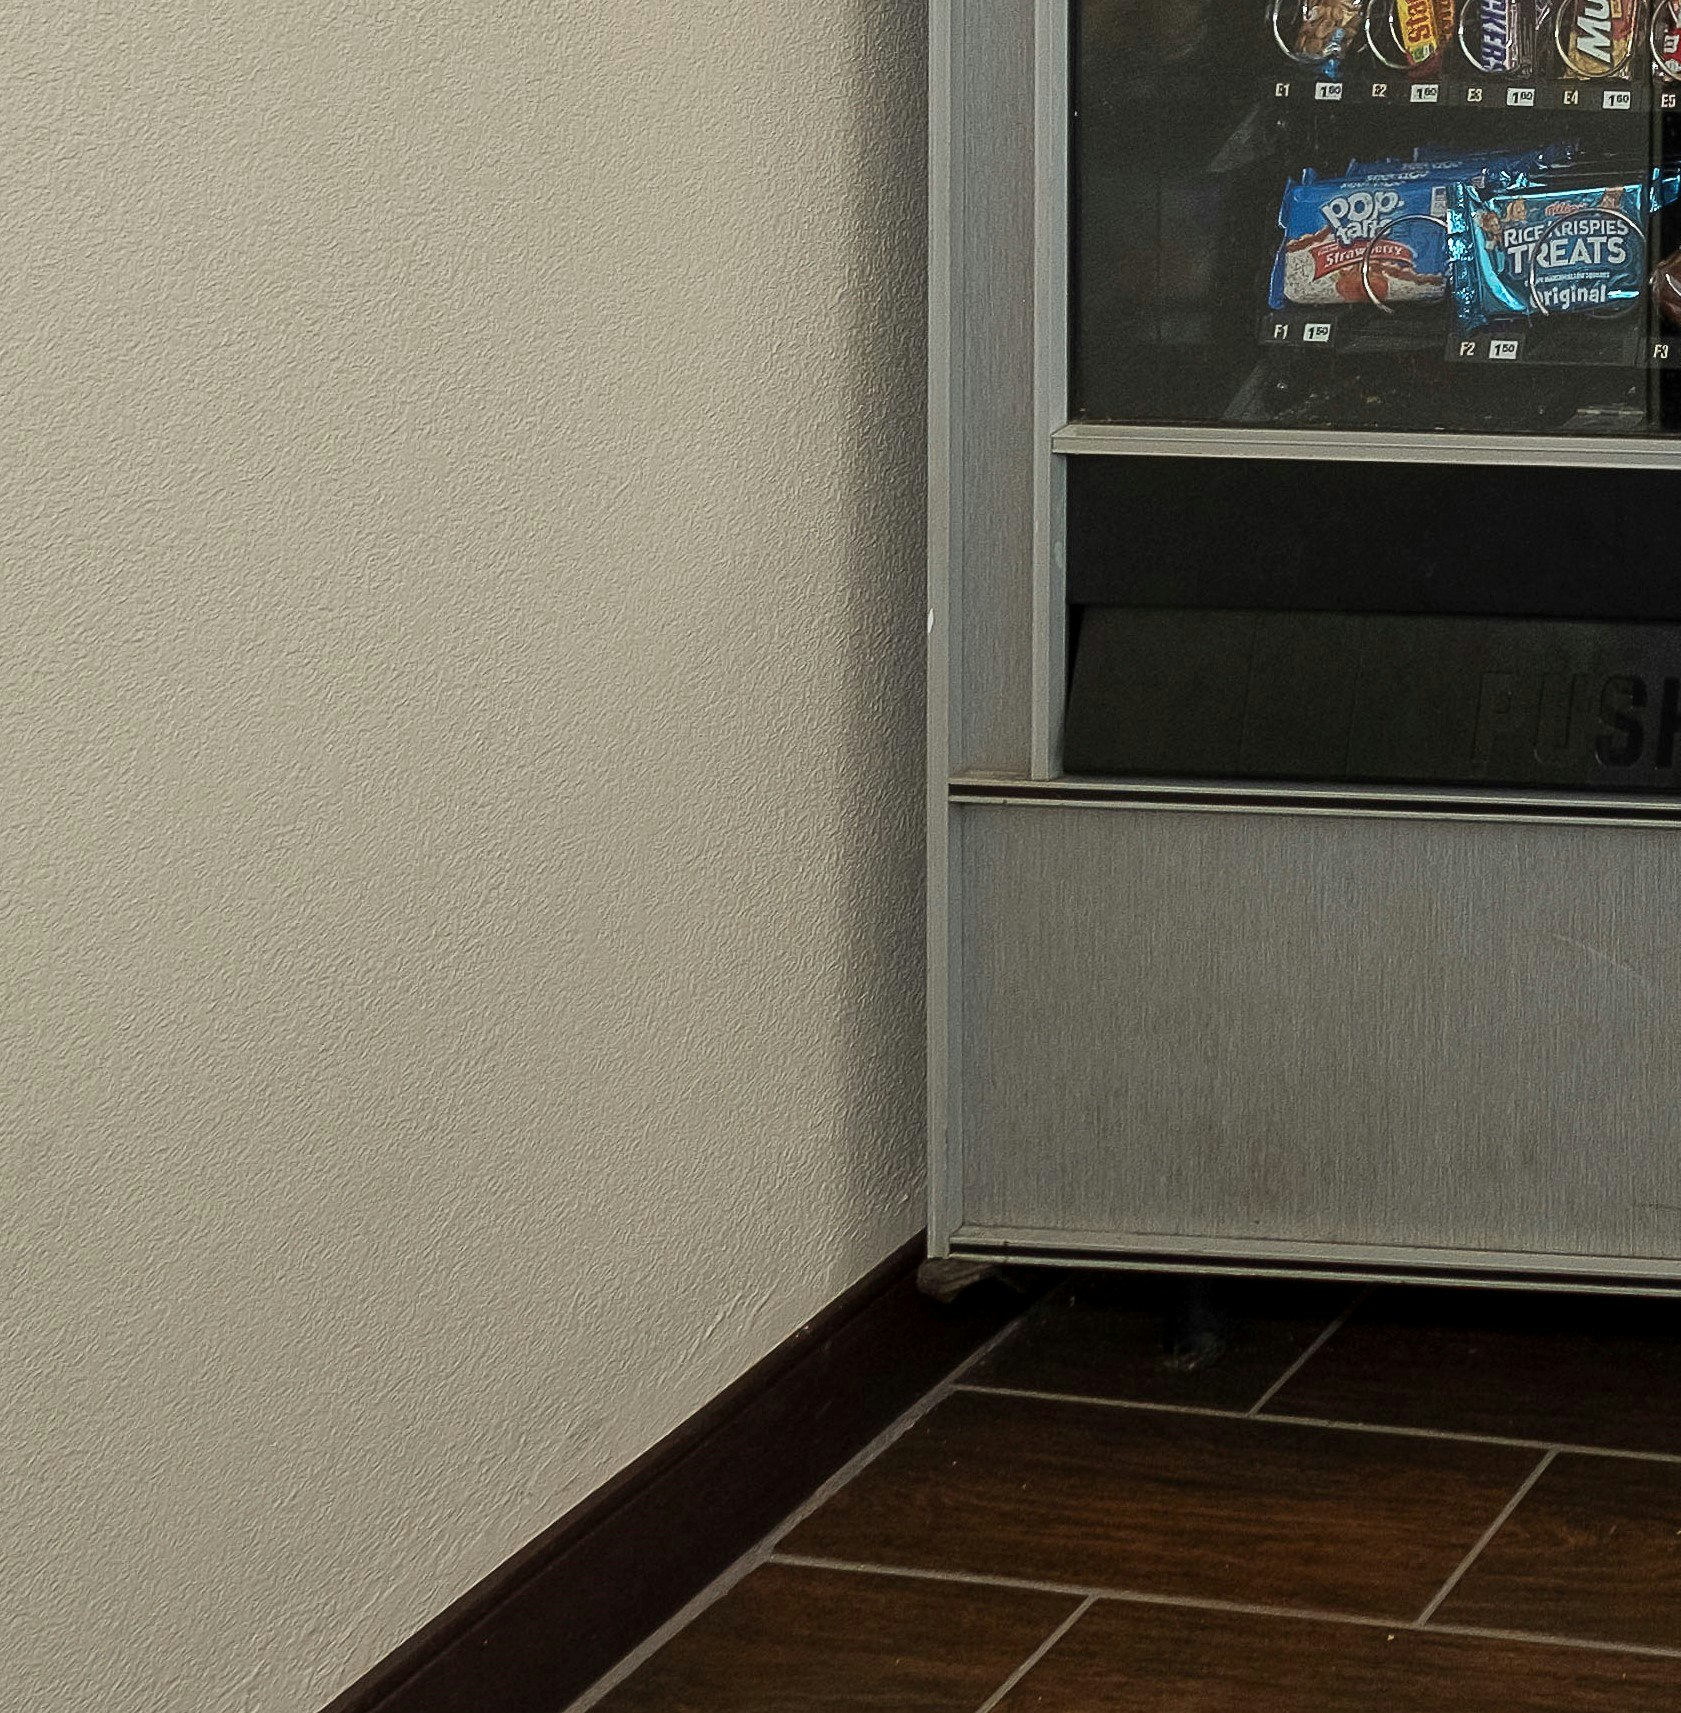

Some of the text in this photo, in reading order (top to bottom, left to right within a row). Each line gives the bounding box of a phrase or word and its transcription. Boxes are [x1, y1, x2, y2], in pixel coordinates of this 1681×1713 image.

[1503, 218, 1630, 246] RICE KRISPIES
[1506, 235, 1628, 275] TREATS
